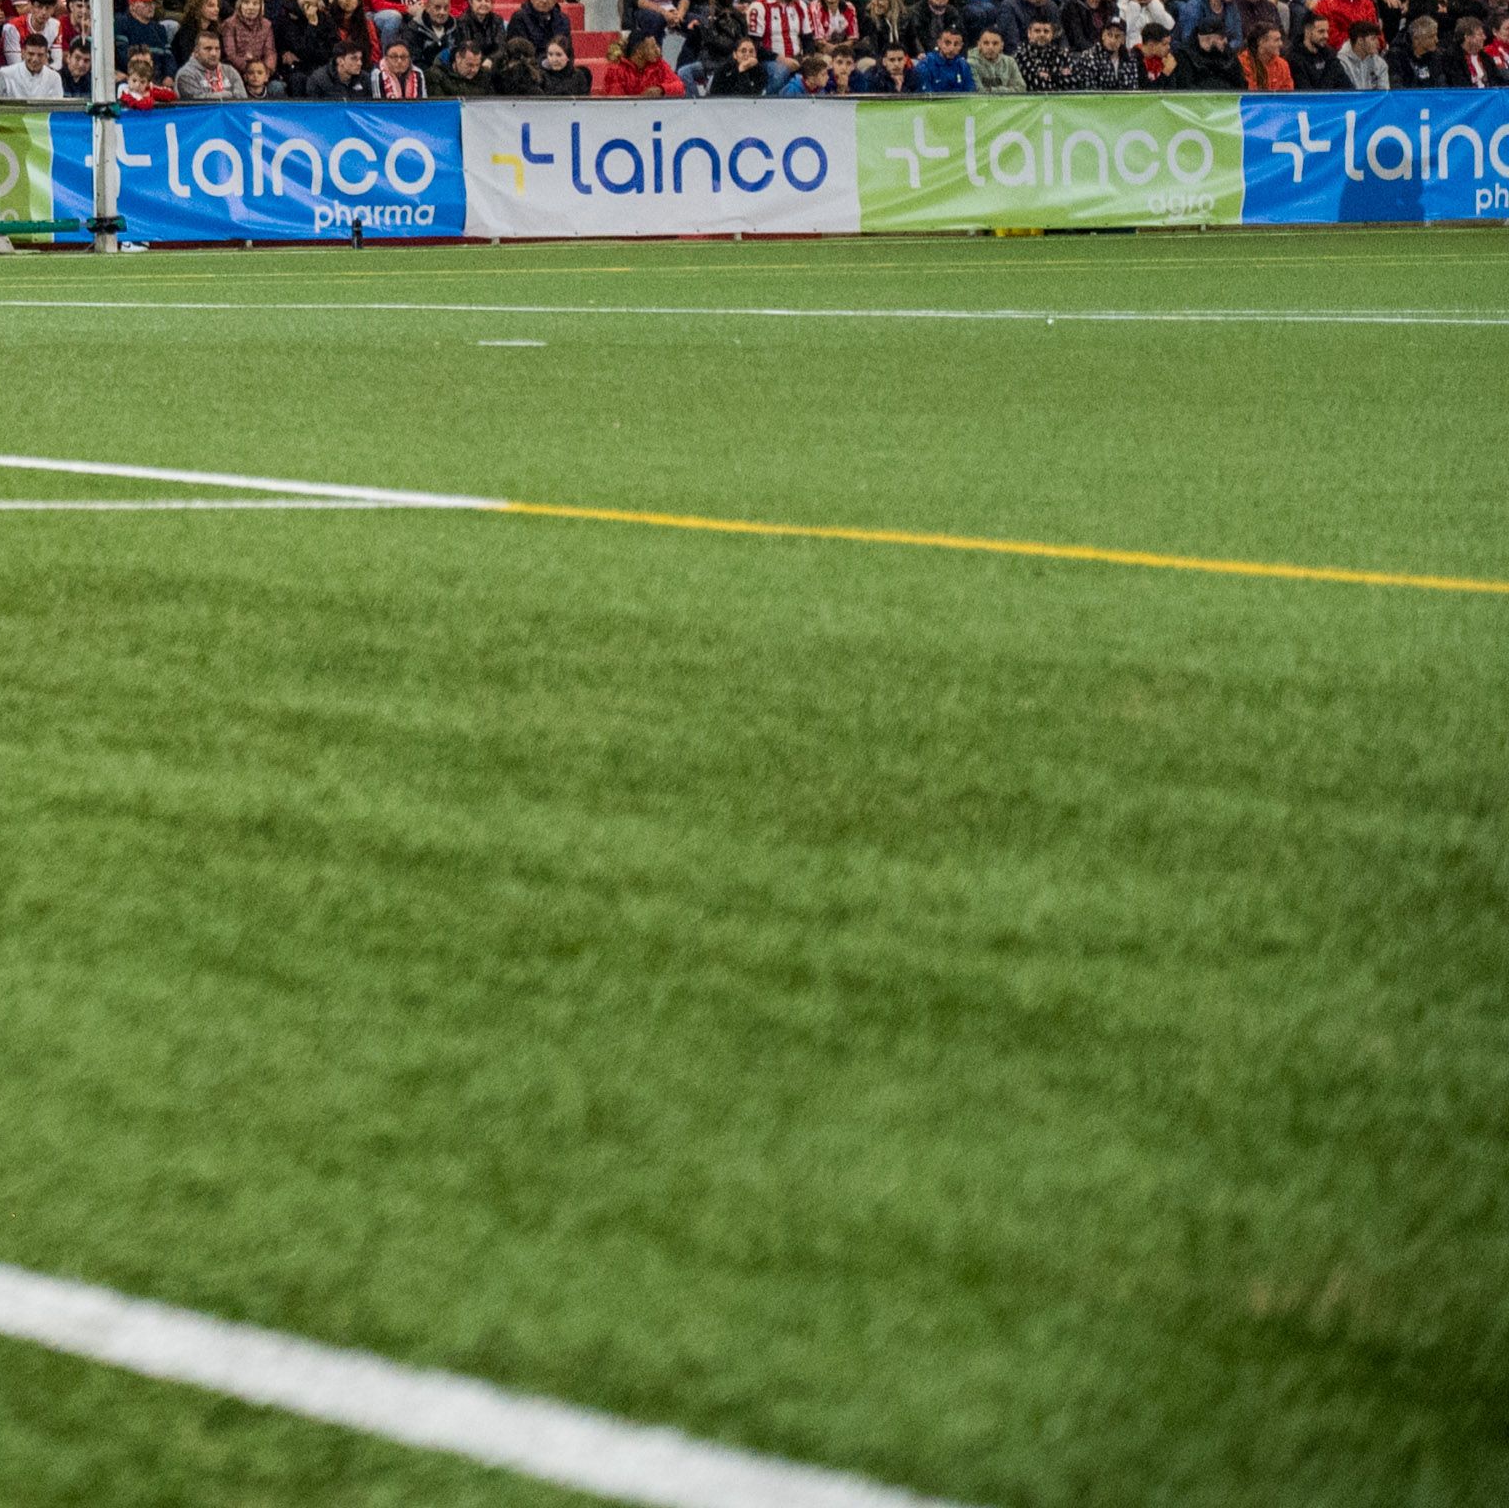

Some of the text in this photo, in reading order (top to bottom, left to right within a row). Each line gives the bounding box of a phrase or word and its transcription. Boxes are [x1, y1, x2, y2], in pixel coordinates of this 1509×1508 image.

[165, 121, 436, 198] lainco
[571, 121, 829, 194] lainco
[965, 112, 1214, 187] lainco
[314, 200, 435, 231] pharma
[1148, 192, 1214, 217] agro
